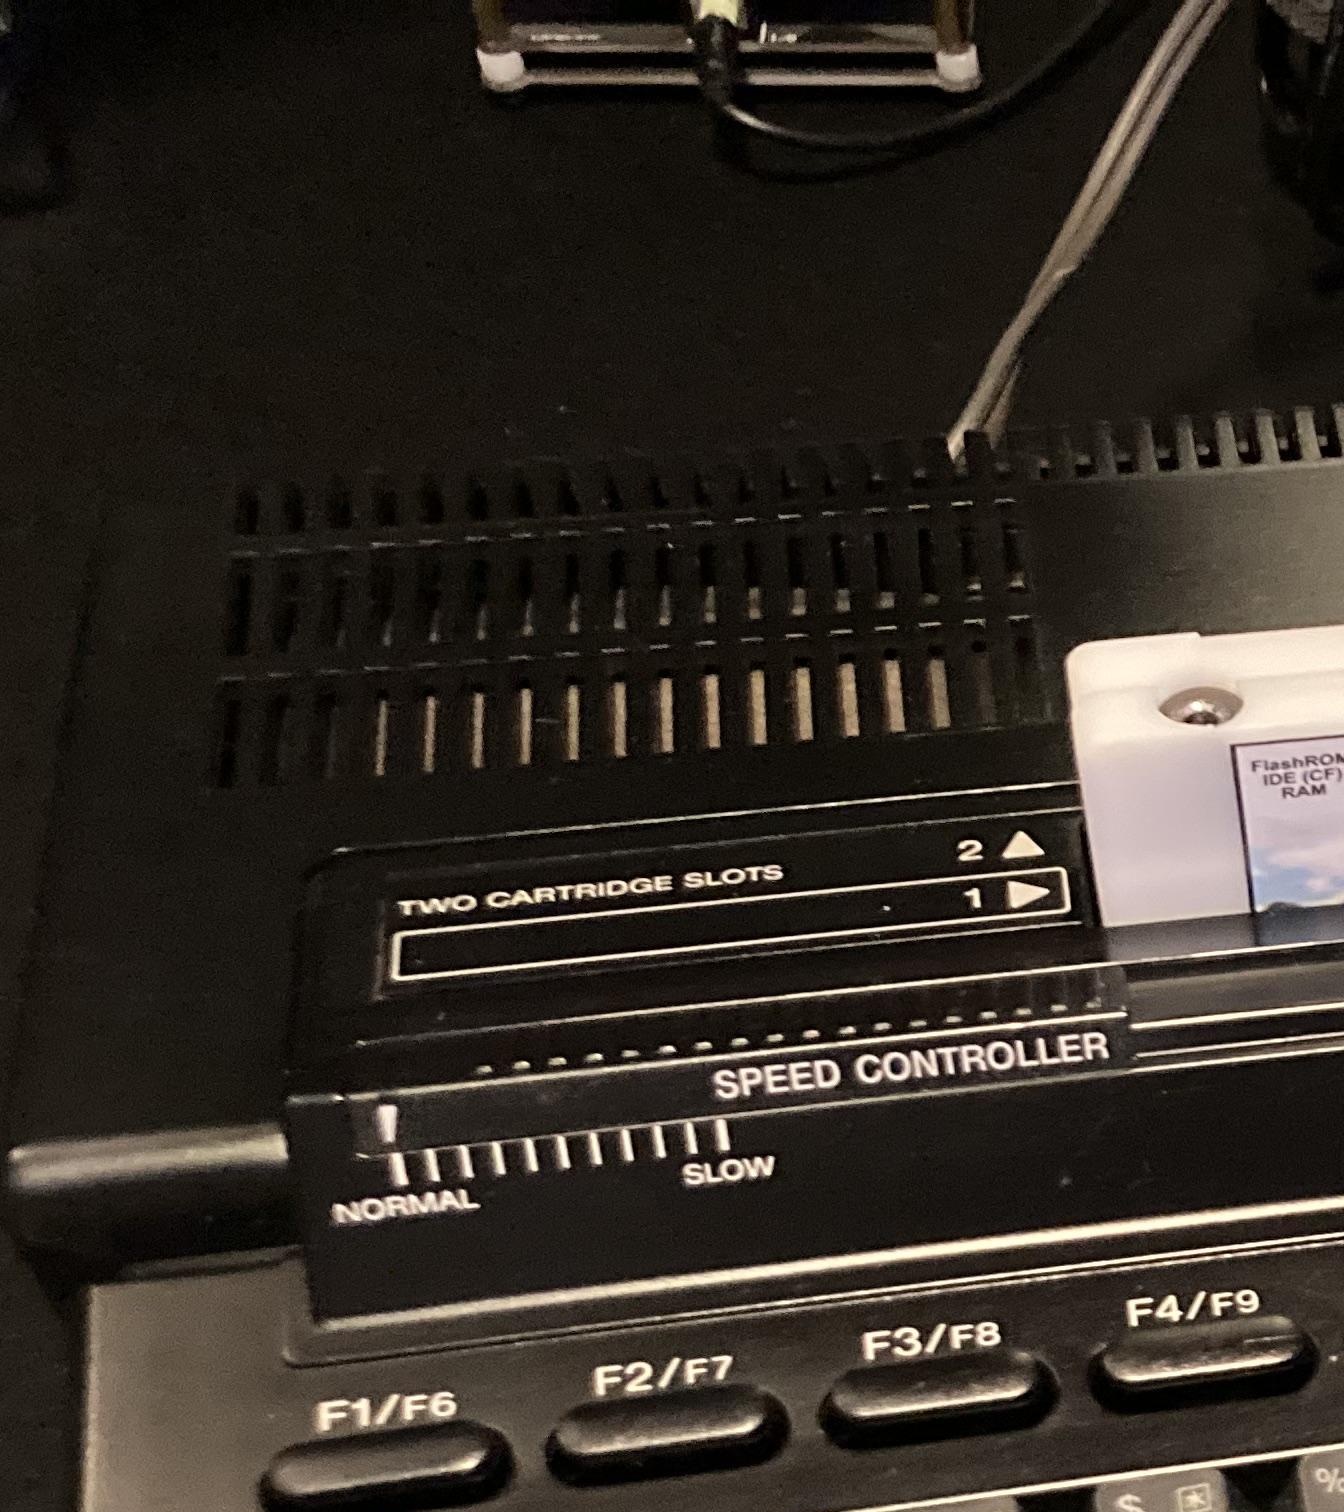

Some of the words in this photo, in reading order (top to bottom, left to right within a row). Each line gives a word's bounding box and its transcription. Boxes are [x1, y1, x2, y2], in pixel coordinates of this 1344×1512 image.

[1261, 770, 1303, 787] IDE
[1307, 767, 1344, 786] (CF)
[1282, 782, 1328, 799] RAM
[957, 839, 983, 860] 2
[398, 895, 477, 917] TWO
[487, 874, 673, 908] CARTRIDGE
[683, 863, 784, 888] SLOTS
[965, 887, 982, 909] 1
[714, 1059, 841, 1100] SPEED
[855, 1032, 1109, 1086] CONTROLLER
[682, 1155, 774, 1186] SLOW
[330, 1189, 480, 1225] NORMAL
[1124, 1289, 1260, 1328] F4/F9
[863, 1321, 1002, 1360] F3/F8
[594, 1356, 734, 1396] F2/F7
[318, 1391, 458, 1432] F1/F6
